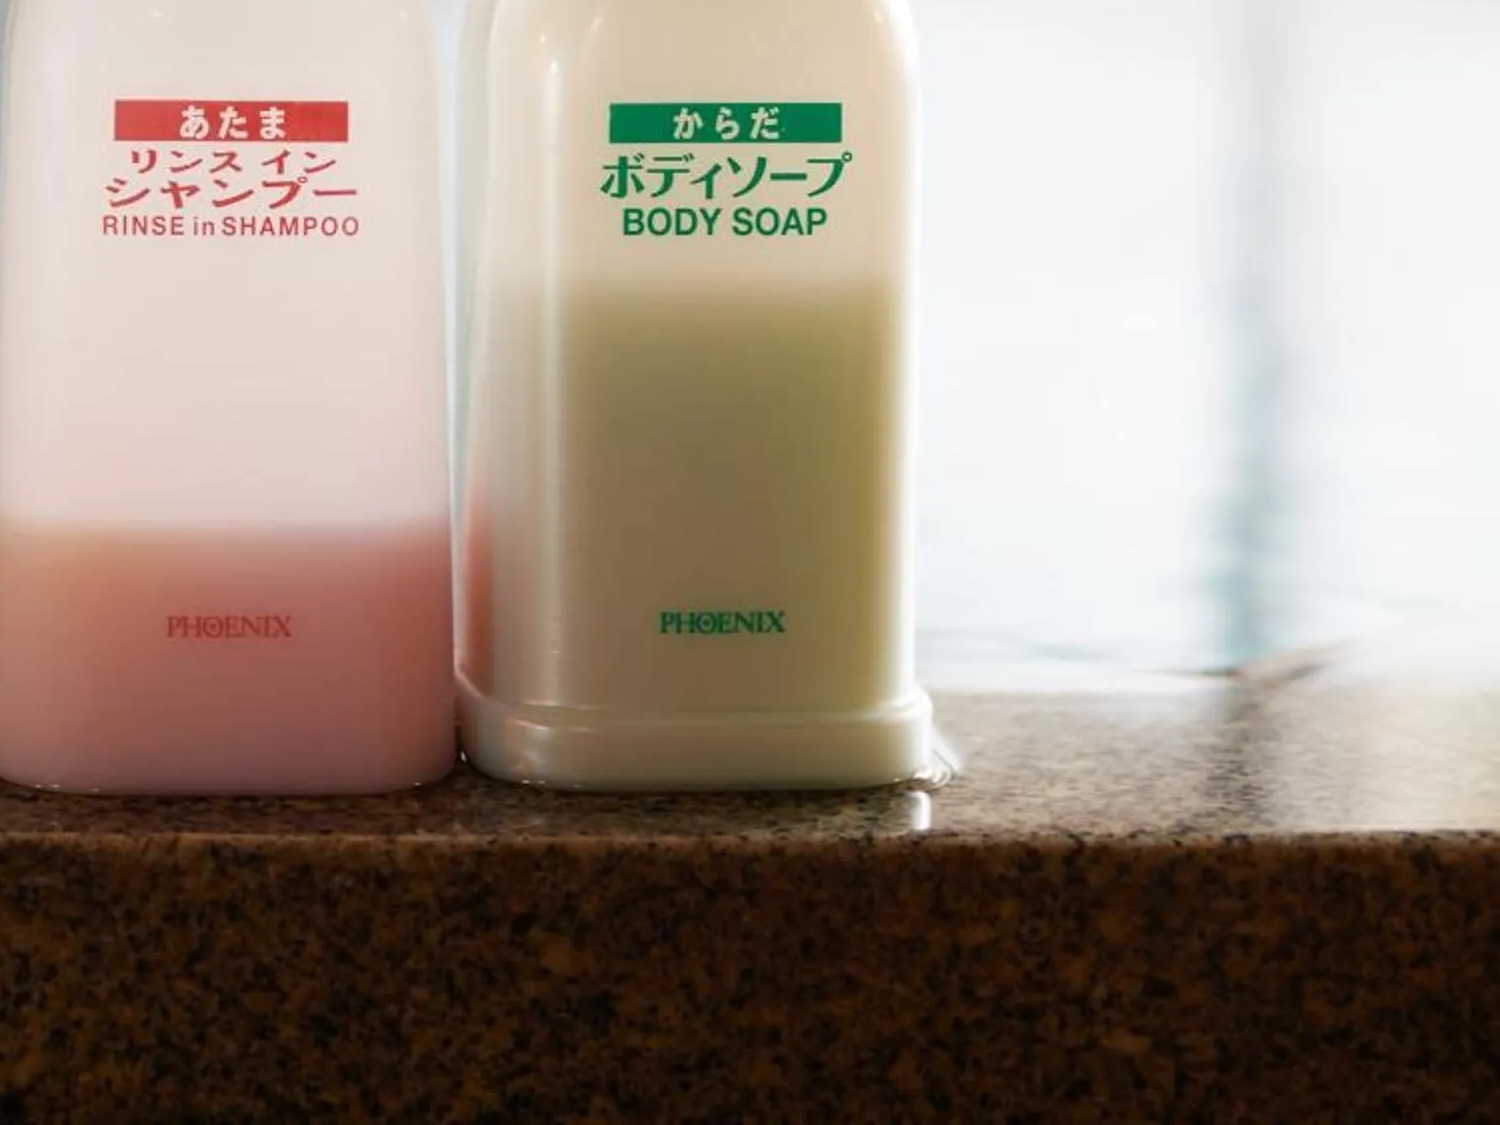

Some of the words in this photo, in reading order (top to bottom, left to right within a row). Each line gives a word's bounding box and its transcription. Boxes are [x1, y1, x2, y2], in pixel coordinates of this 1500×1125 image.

[178, 105, 286, 140] あたま
[672, 106, 781, 141] からだ
[599, 151, 854, 200] ボディソープ
[105, 176, 358, 210] シャンプー
[101, 216, 186, 236] RINSE
[192, 216, 216, 236] in
[220, 216, 360, 237] SHAMPOO
[622, 207, 723, 237] BODY
[731, 207, 828, 237] SOAP
[166, 614, 293, 639] PHOENIX
[659, 610, 787, 635] PHOENIX
